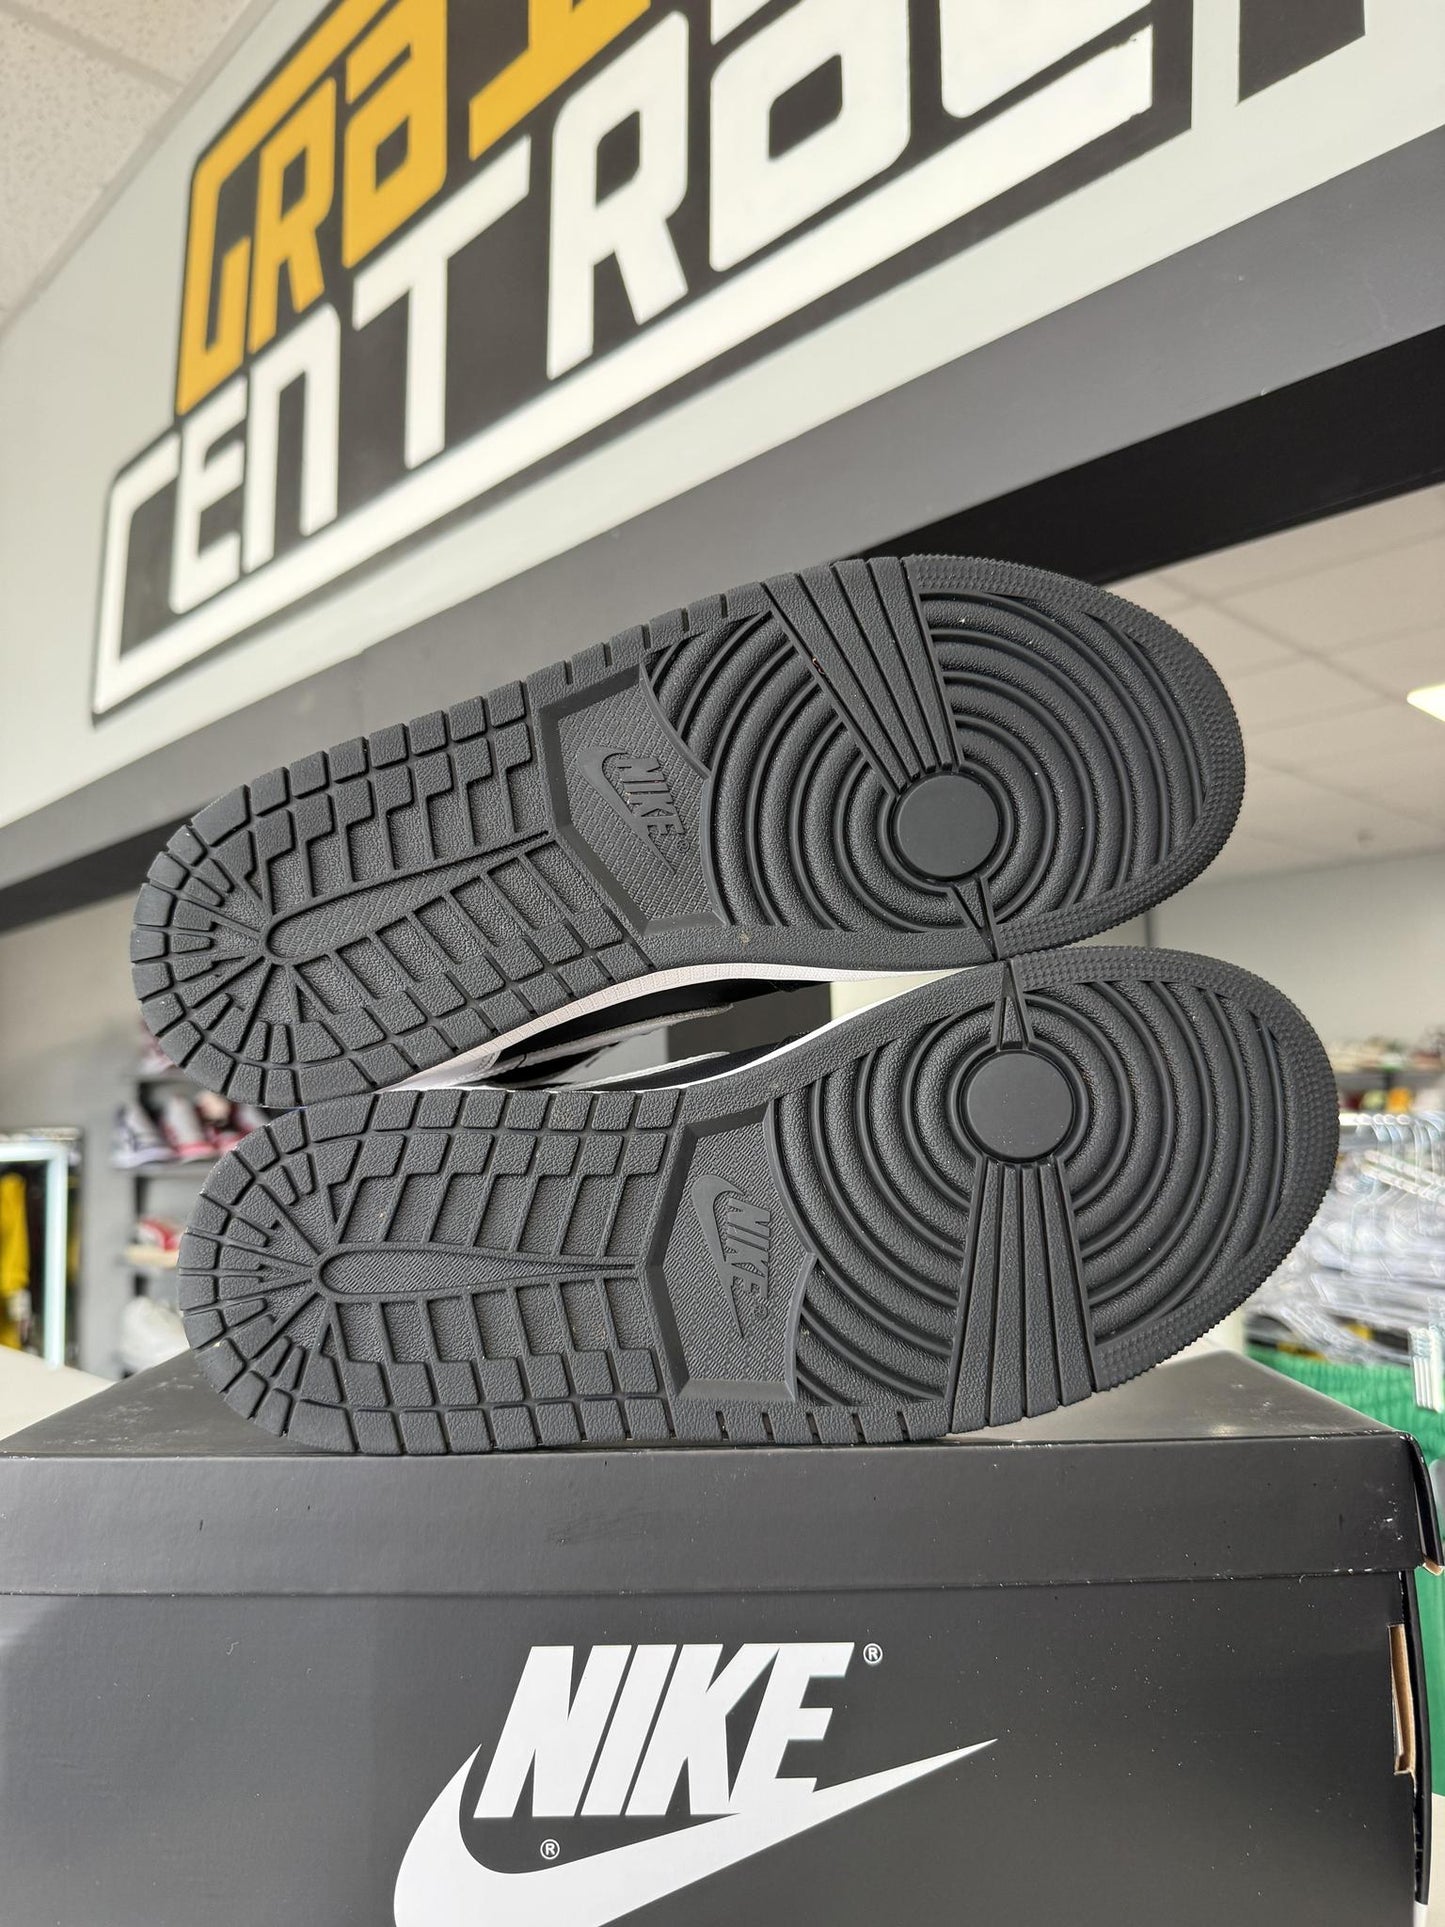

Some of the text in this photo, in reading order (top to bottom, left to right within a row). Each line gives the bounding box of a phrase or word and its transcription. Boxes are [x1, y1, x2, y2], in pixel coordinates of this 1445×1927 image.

[614, 757, 686, 836] NIKE
[725, 1197, 771, 1300] NIKE
[473, 1641, 855, 1819] NIKE
